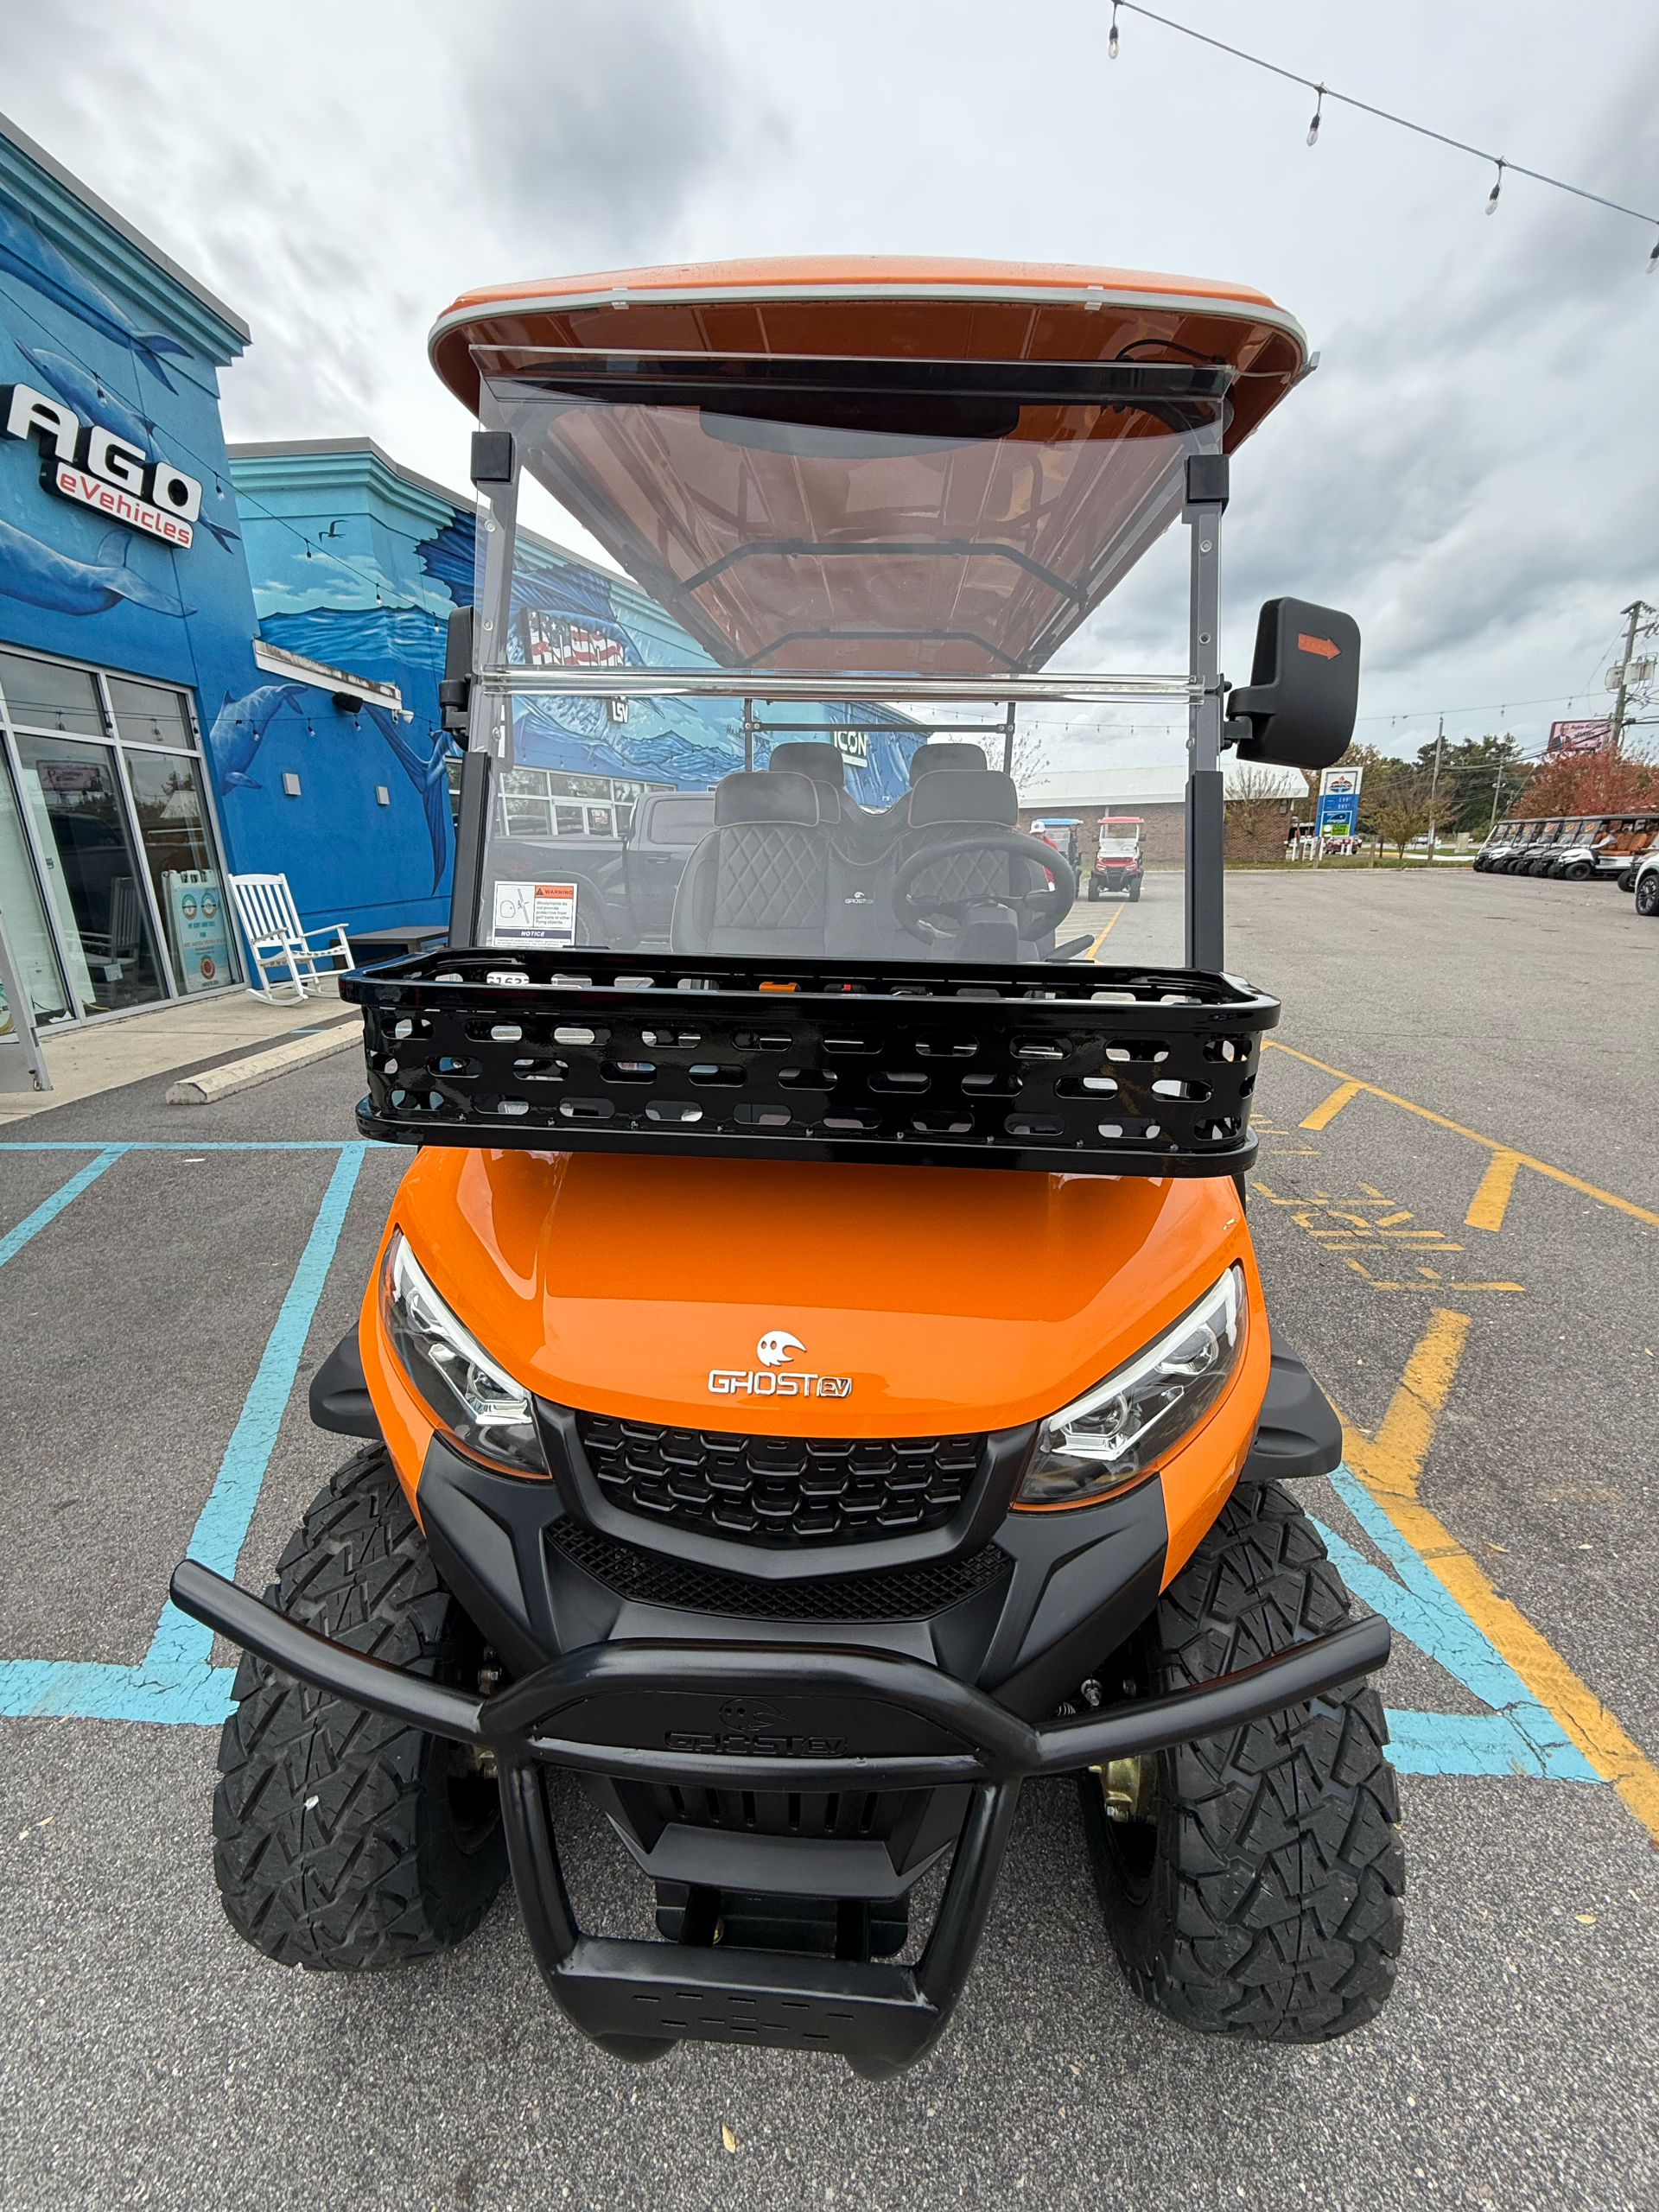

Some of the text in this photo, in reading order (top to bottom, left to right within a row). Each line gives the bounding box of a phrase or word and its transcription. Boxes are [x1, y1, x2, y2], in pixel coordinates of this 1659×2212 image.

[7, 383, 202, 523] AGO
[60, 473, 191, 545] eVehicles
[612, 701, 629, 723] LSV
